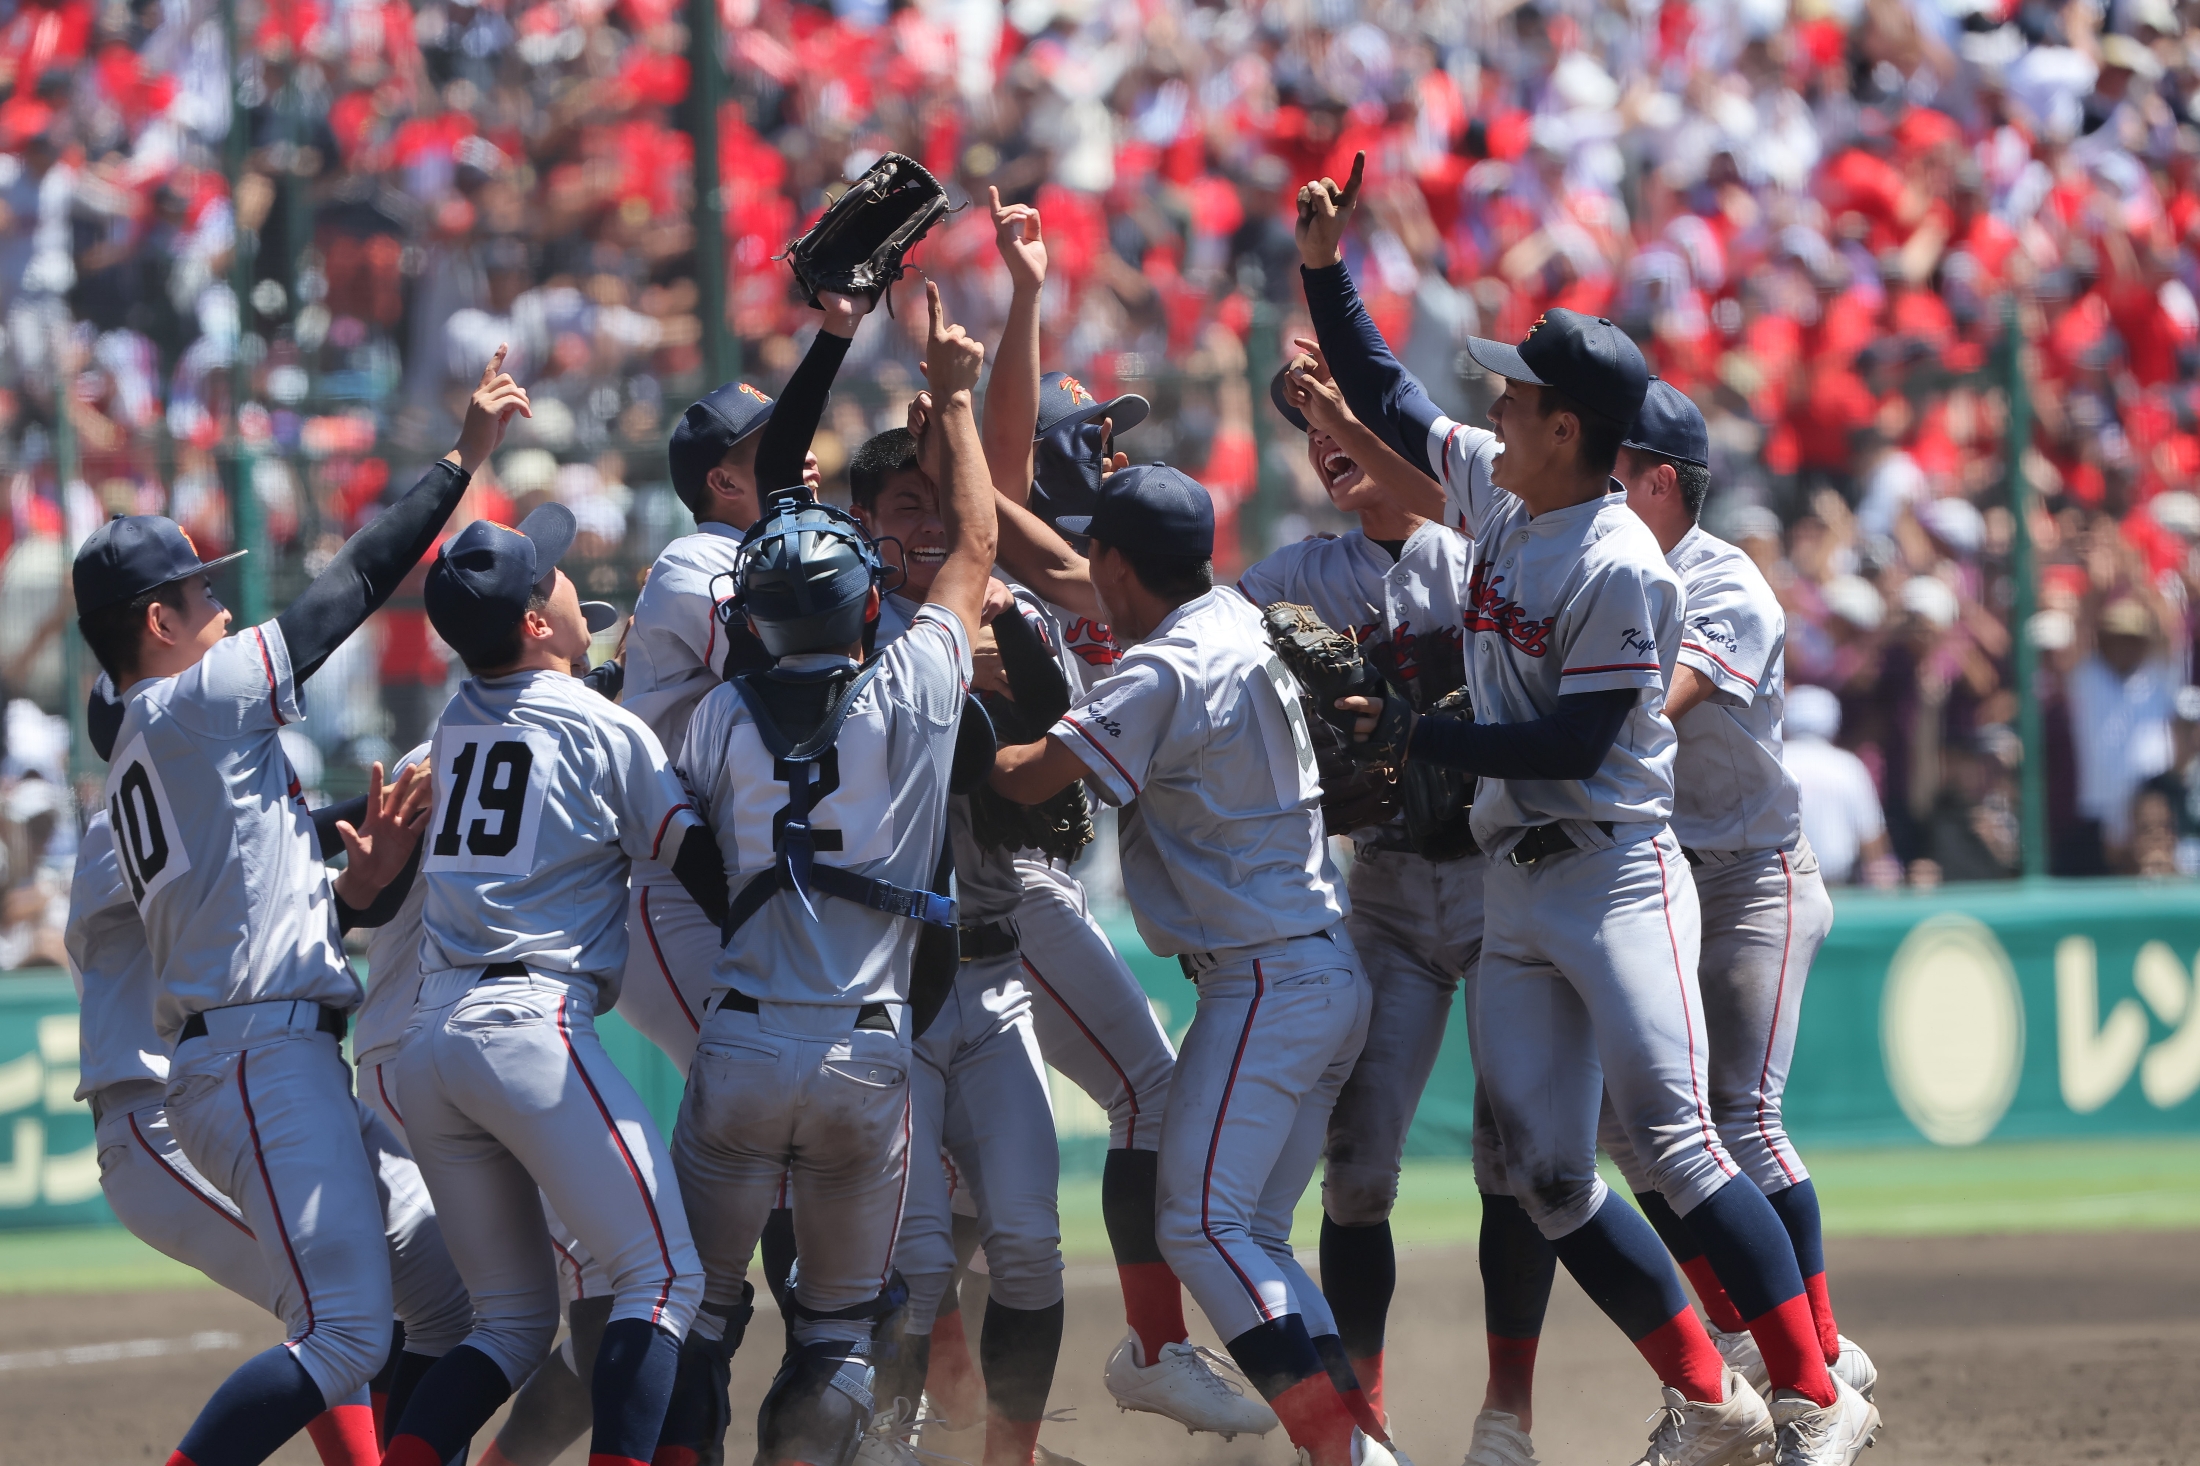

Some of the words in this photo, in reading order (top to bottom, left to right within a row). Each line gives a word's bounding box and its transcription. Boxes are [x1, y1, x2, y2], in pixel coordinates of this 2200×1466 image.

[1693, 616, 1737, 653] Kyoto
[111, 760, 169, 907] 10
[433, 741, 534, 857] 19
[772, 744, 843, 853] 2
